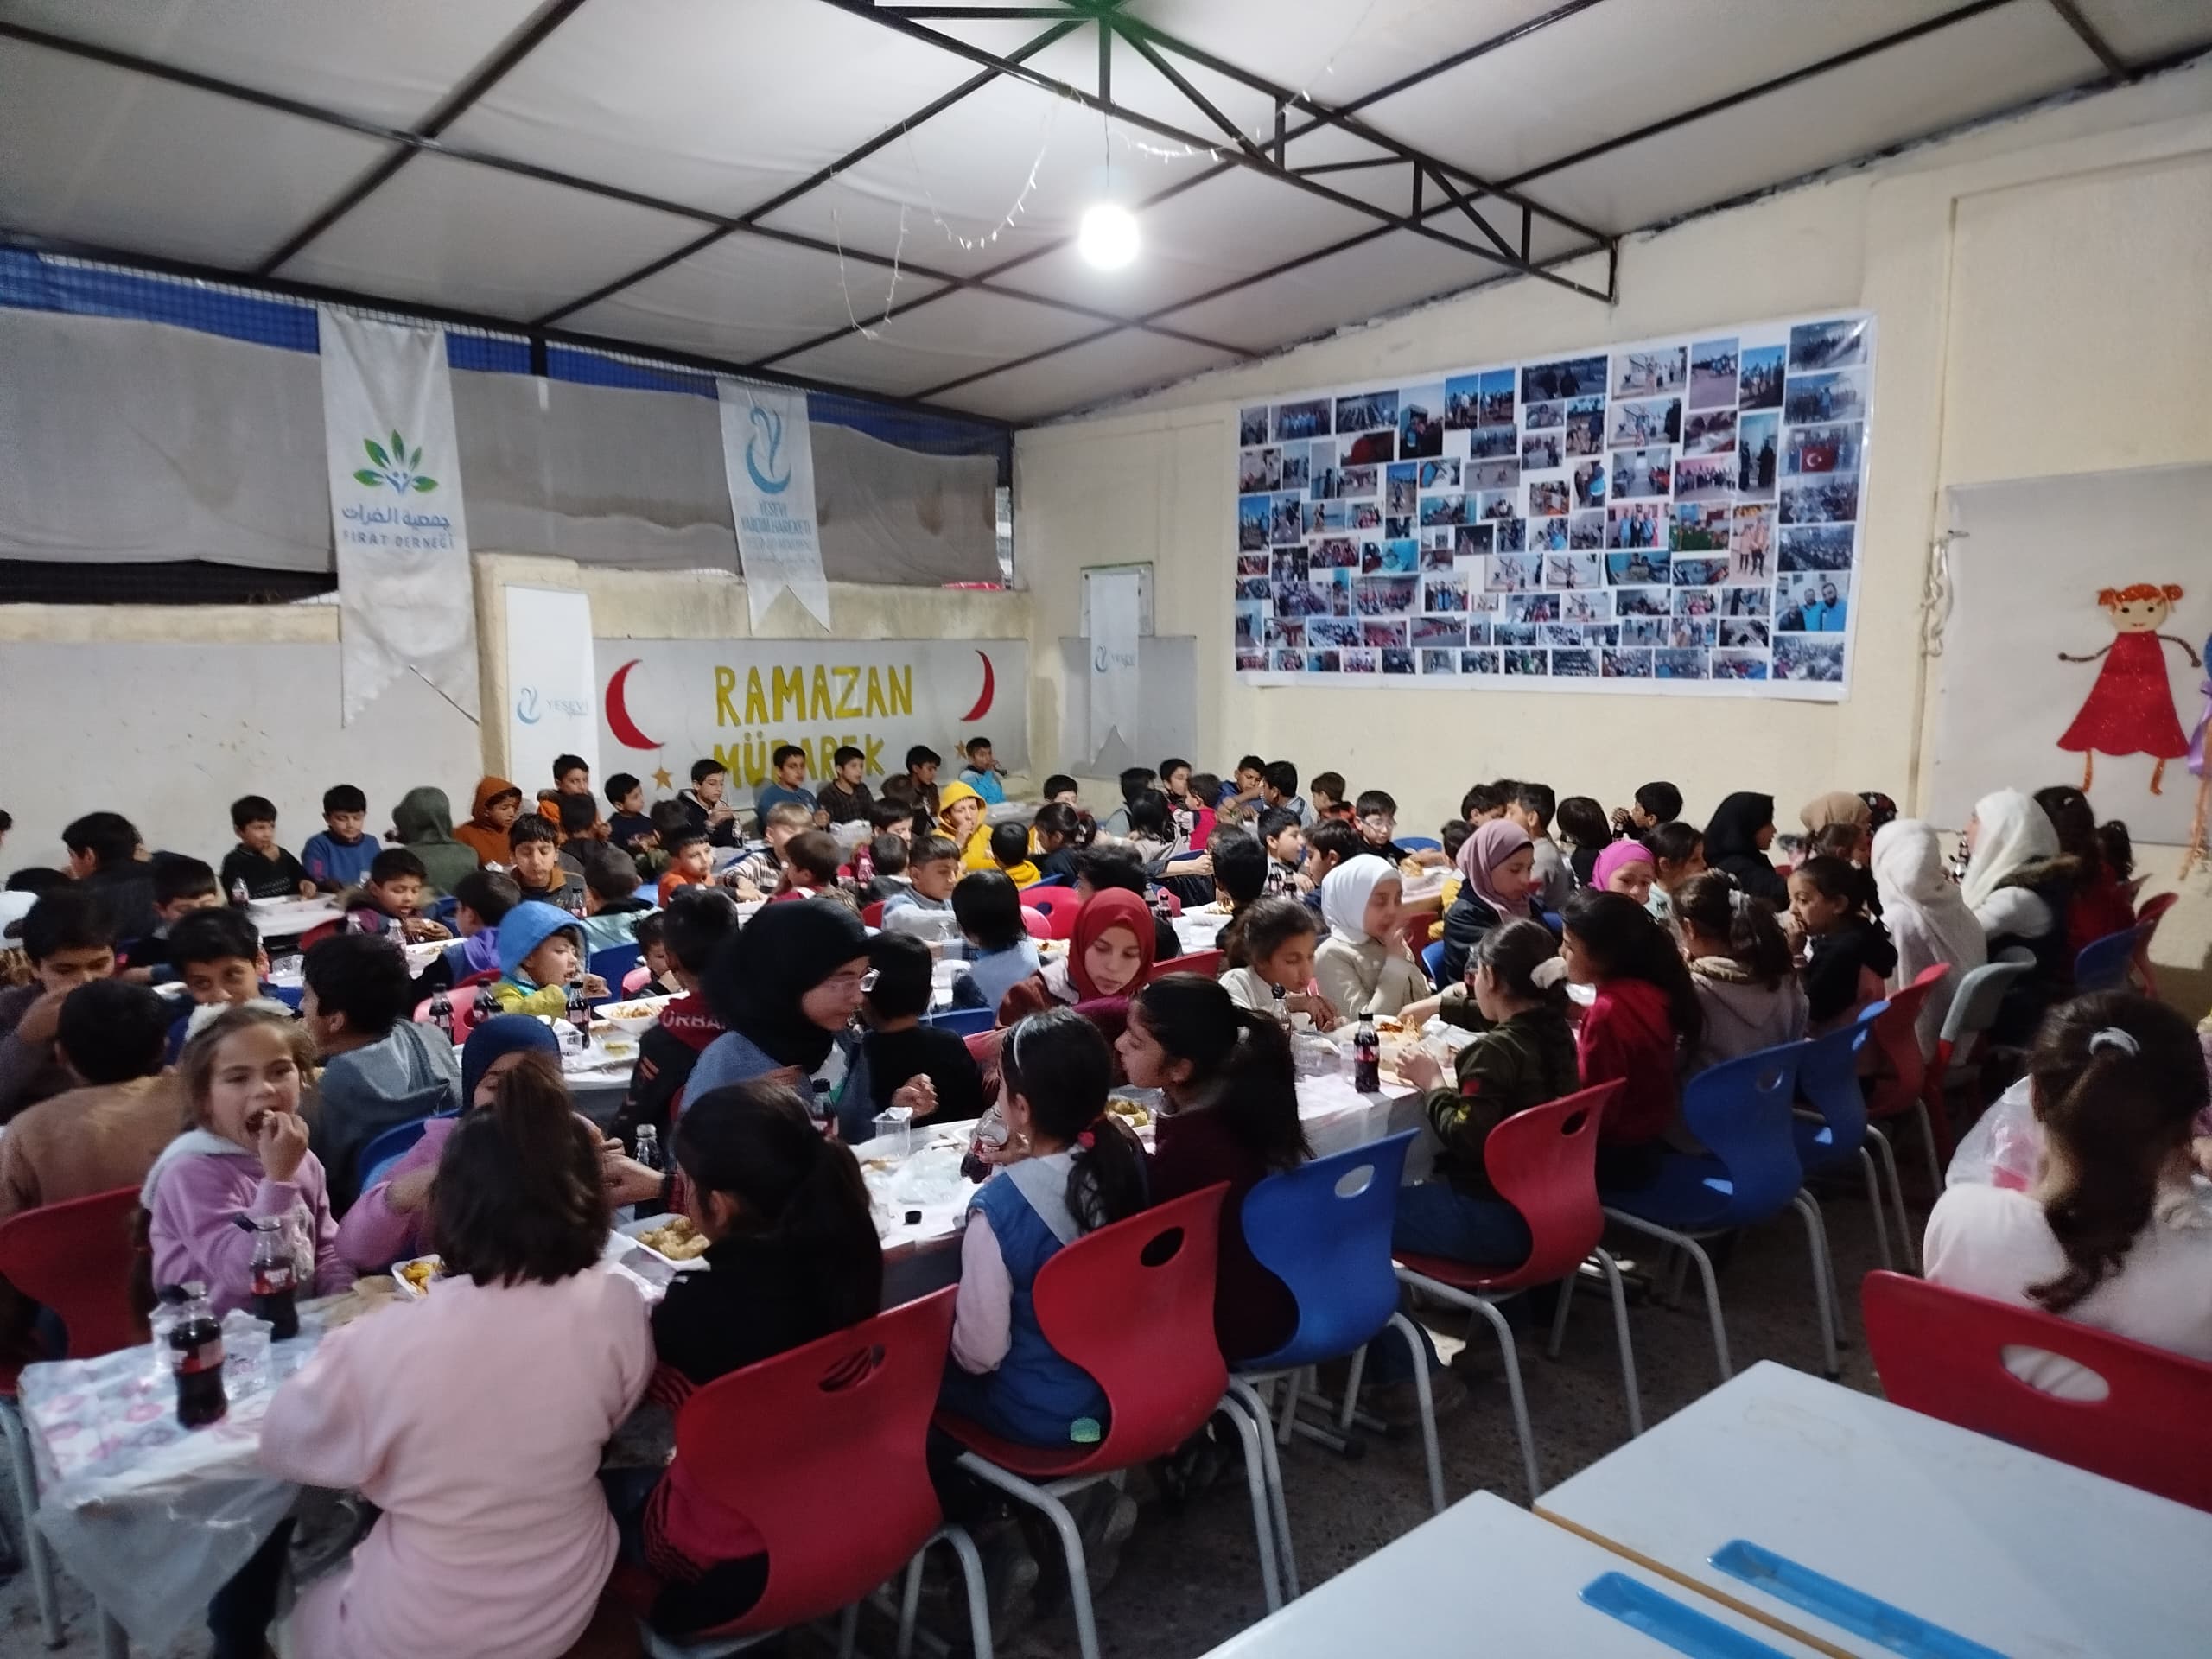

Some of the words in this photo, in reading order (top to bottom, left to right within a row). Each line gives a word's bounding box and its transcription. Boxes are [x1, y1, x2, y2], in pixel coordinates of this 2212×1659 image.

[341, 503, 397, 526] الفرات
[402, 509, 451, 531] جمعية
[342, 529, 388, 545] FIRAT
[714, 664, 913, 728] RAMAZAN
[713, 730, 886, 789] MÜARK
[662, 1010, 728, 1031] URBA
